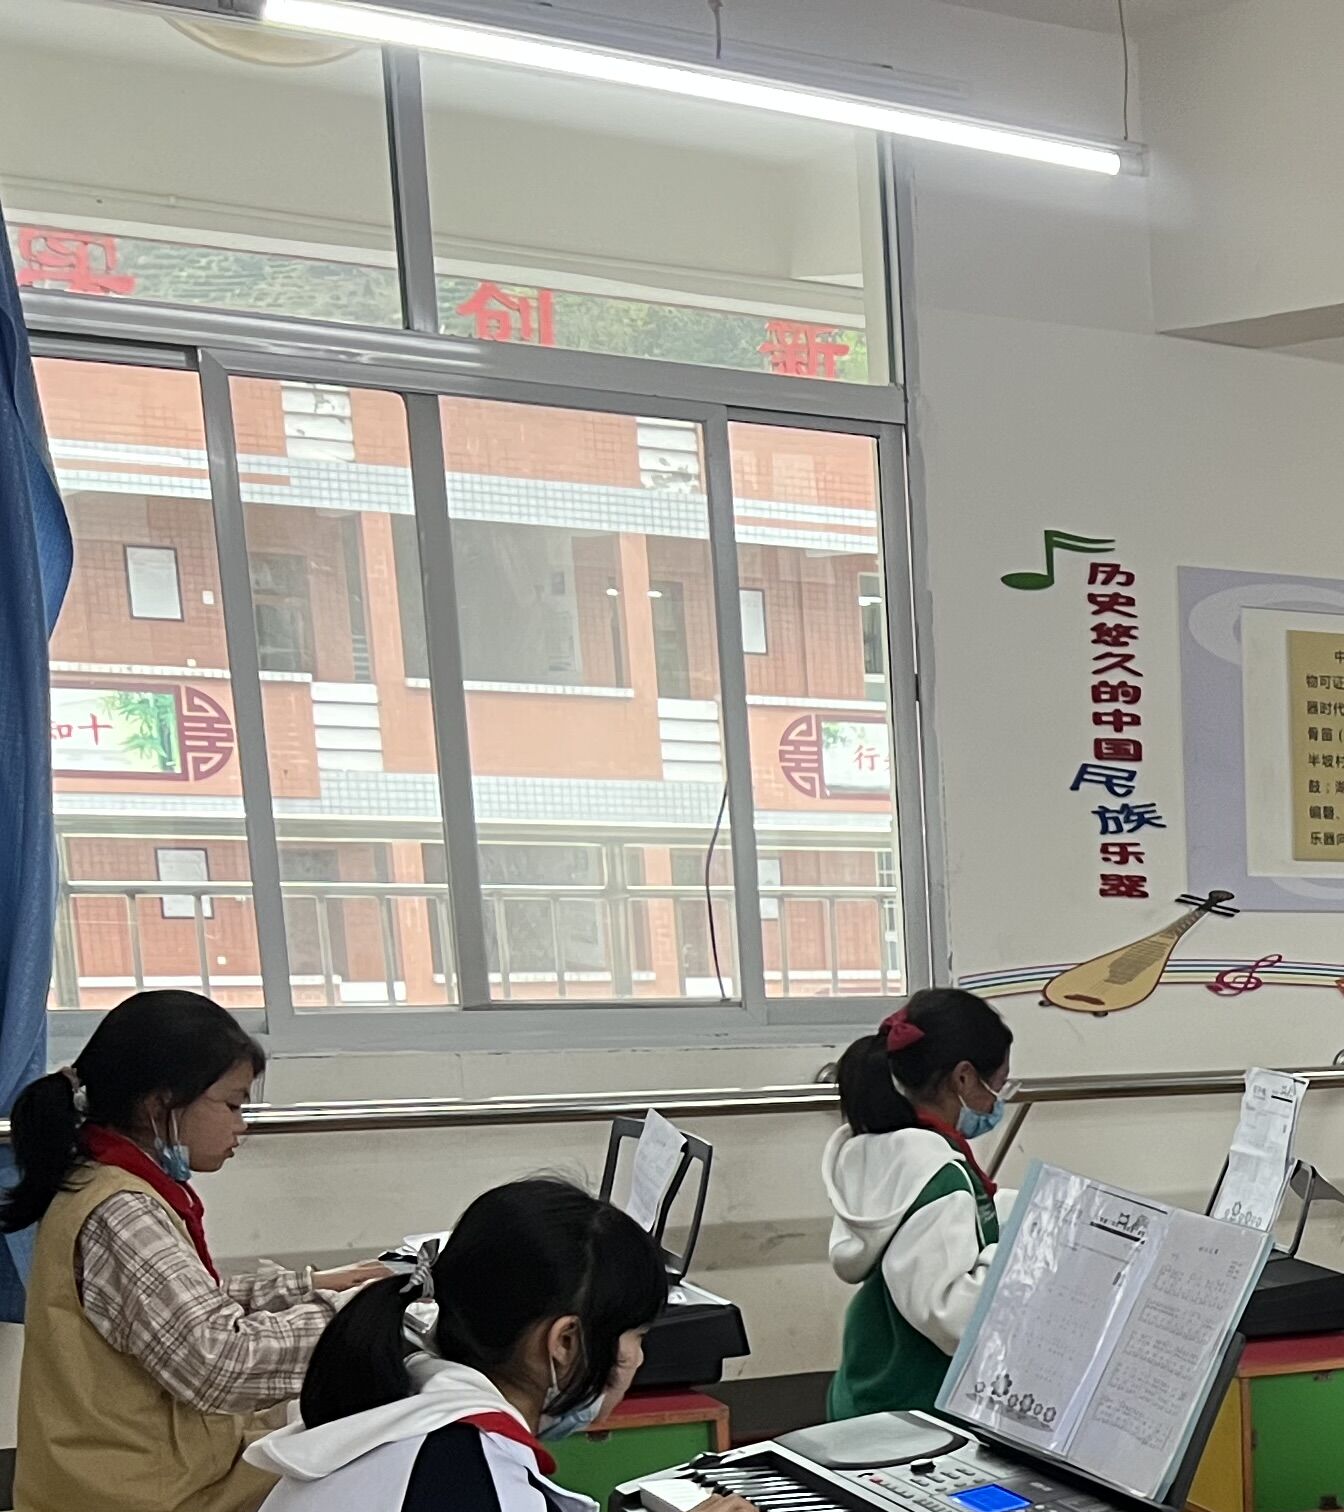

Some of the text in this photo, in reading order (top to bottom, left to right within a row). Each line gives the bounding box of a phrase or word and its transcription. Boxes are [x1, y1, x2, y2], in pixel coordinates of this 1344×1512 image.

[854, 744, 889, 772] 行
[1070, 562, 1166, 898] 历史悠久的中国民族乐器
